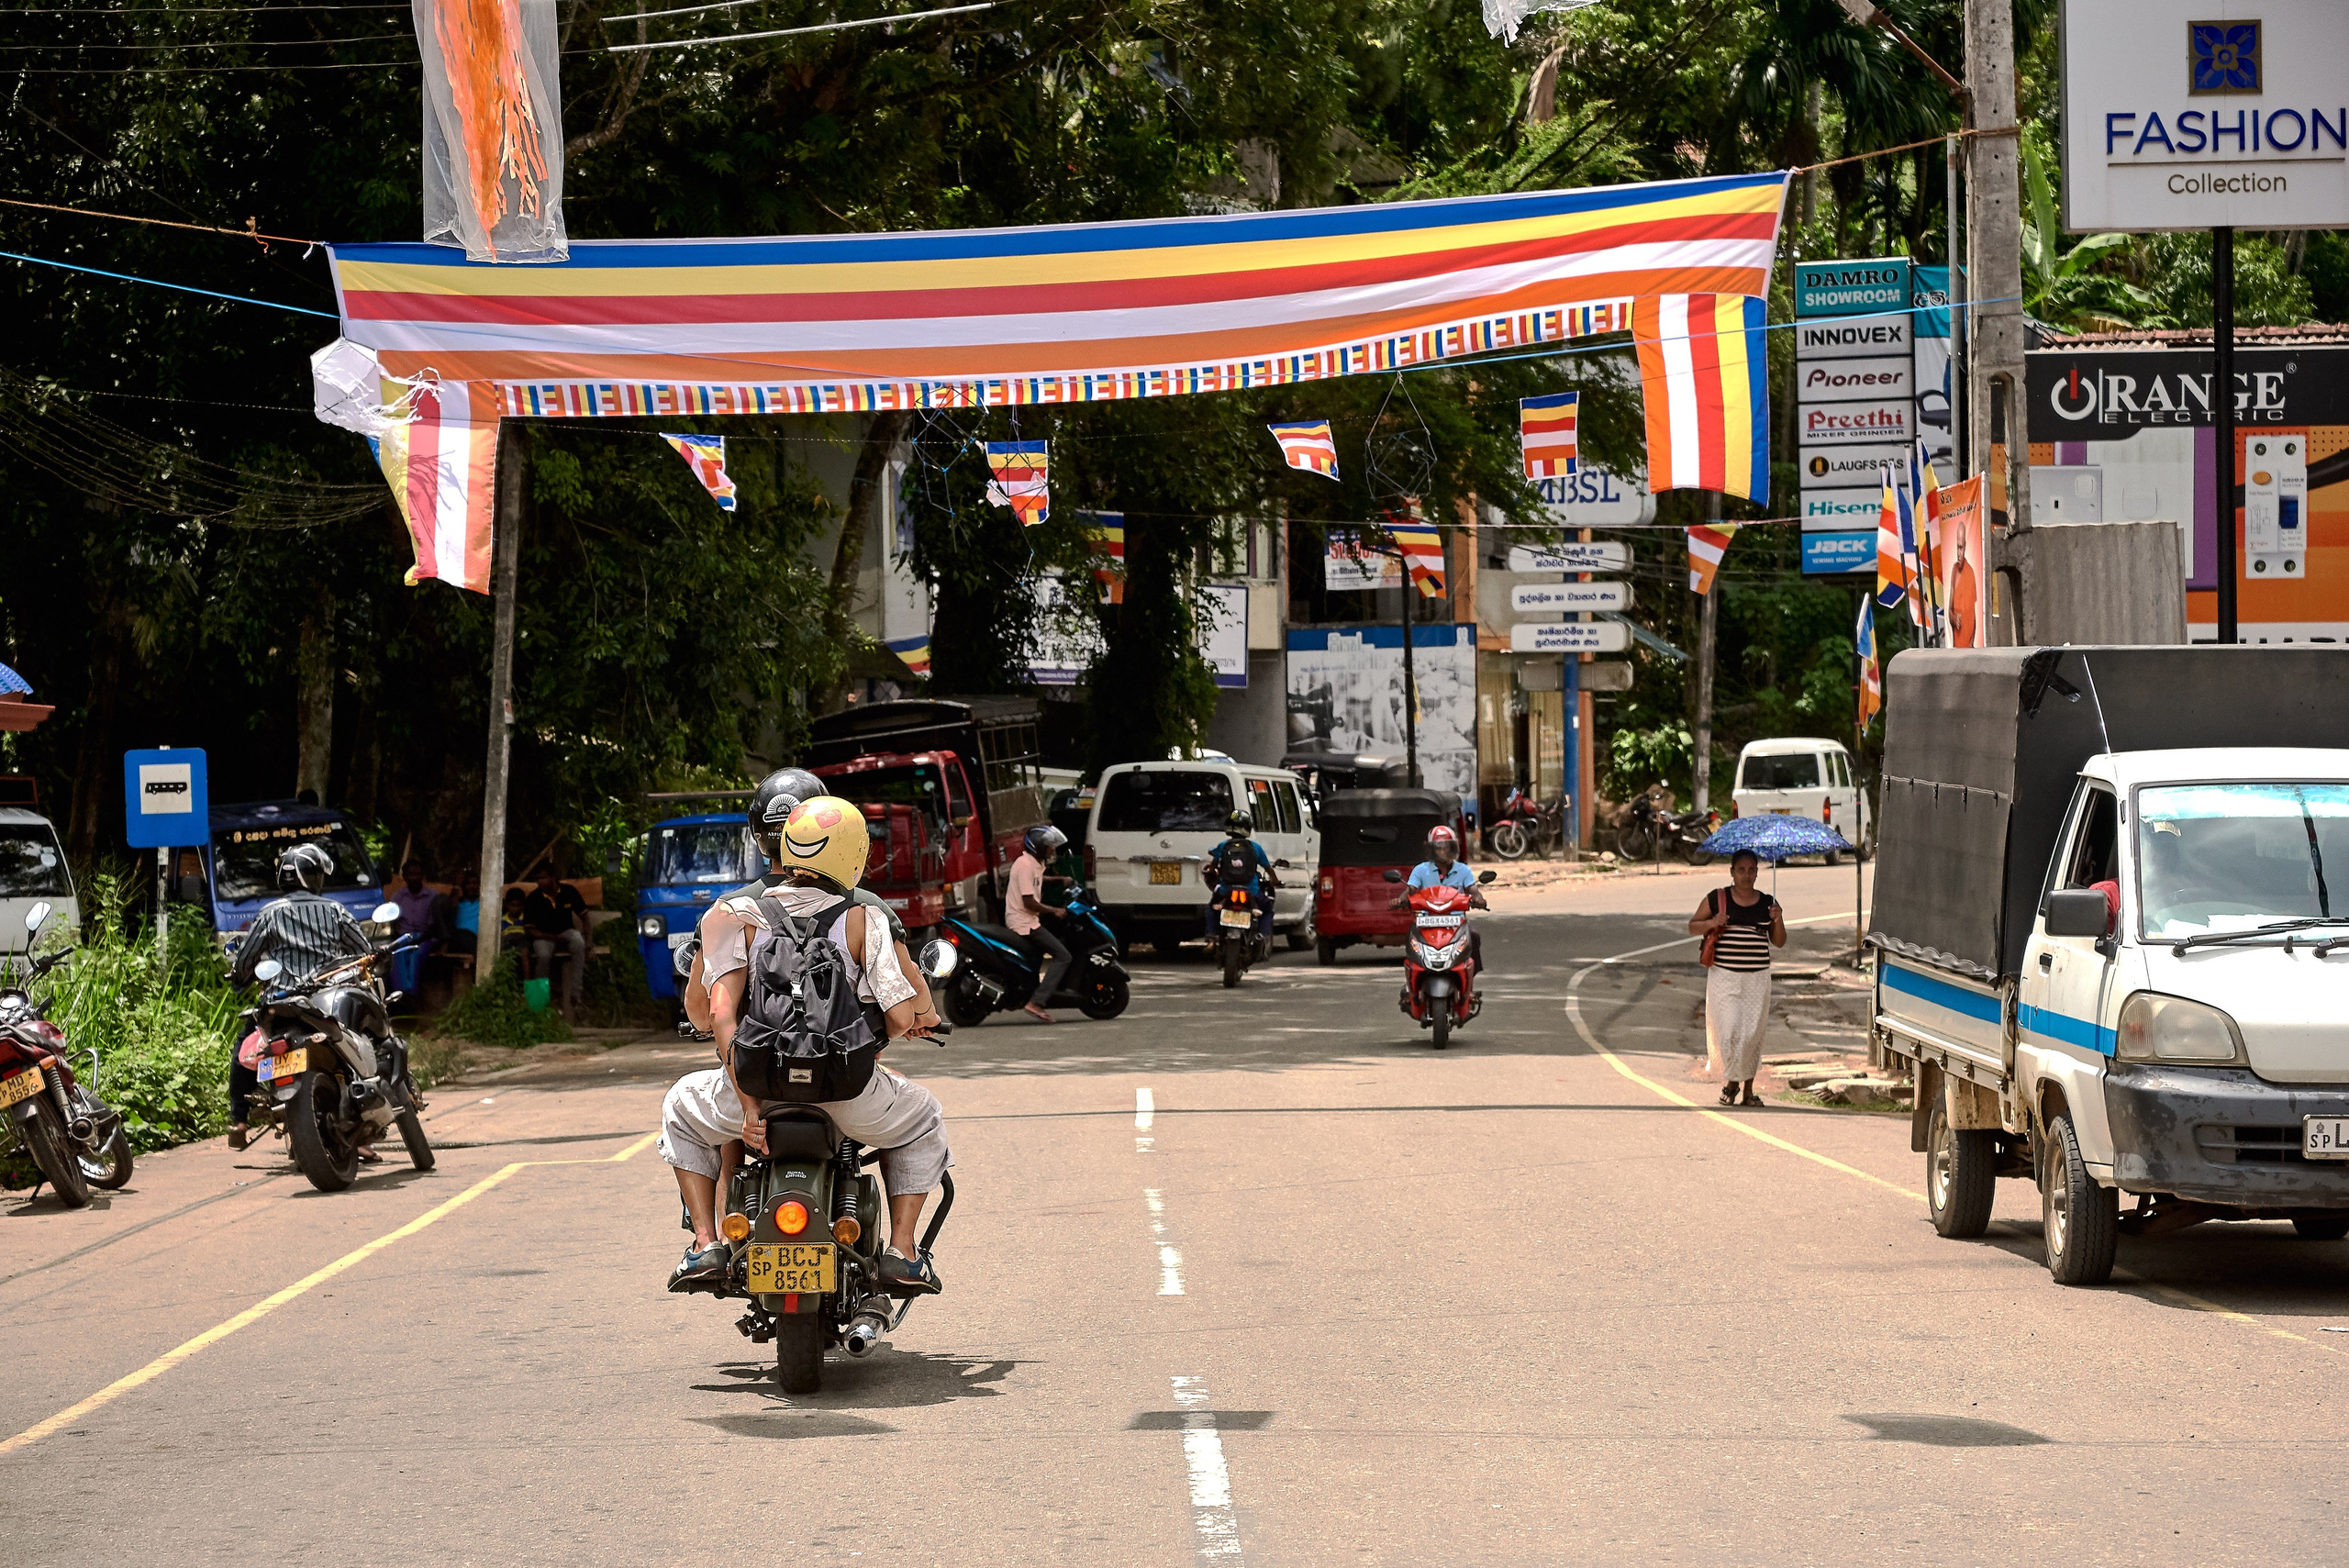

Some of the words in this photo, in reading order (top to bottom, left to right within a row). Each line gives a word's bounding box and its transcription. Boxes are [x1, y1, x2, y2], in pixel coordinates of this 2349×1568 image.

[2107, 108, 2347, 155] FASHION
[2167, 172, 2287, 195] Collection
[1804, 269, 1898, 288] DAMRO
[1805, 289, 1900, 306] SHOWROOM
[1804, 326, 1902, 347] INNOVEX
[1806, 369, 1903, 387] Pioneer
[1807, 408, 1904, 429] Preethi
[2105, 410, 2285, 424] ELECTRIC
[1850, 429, 1904, 438] GRINDER
[1831, 460, 1877, 472] LAUGFS
[7, 1074, 25, 1091] MD
[9, 1083, 38, 1103] 8556
[2310, 1134, 2331, 1148] SP
[778, 1247, 821, 1267] BCJ
[752, 1262, 772, 1276] SP
[774, 1270, 822, 1290] 8561
